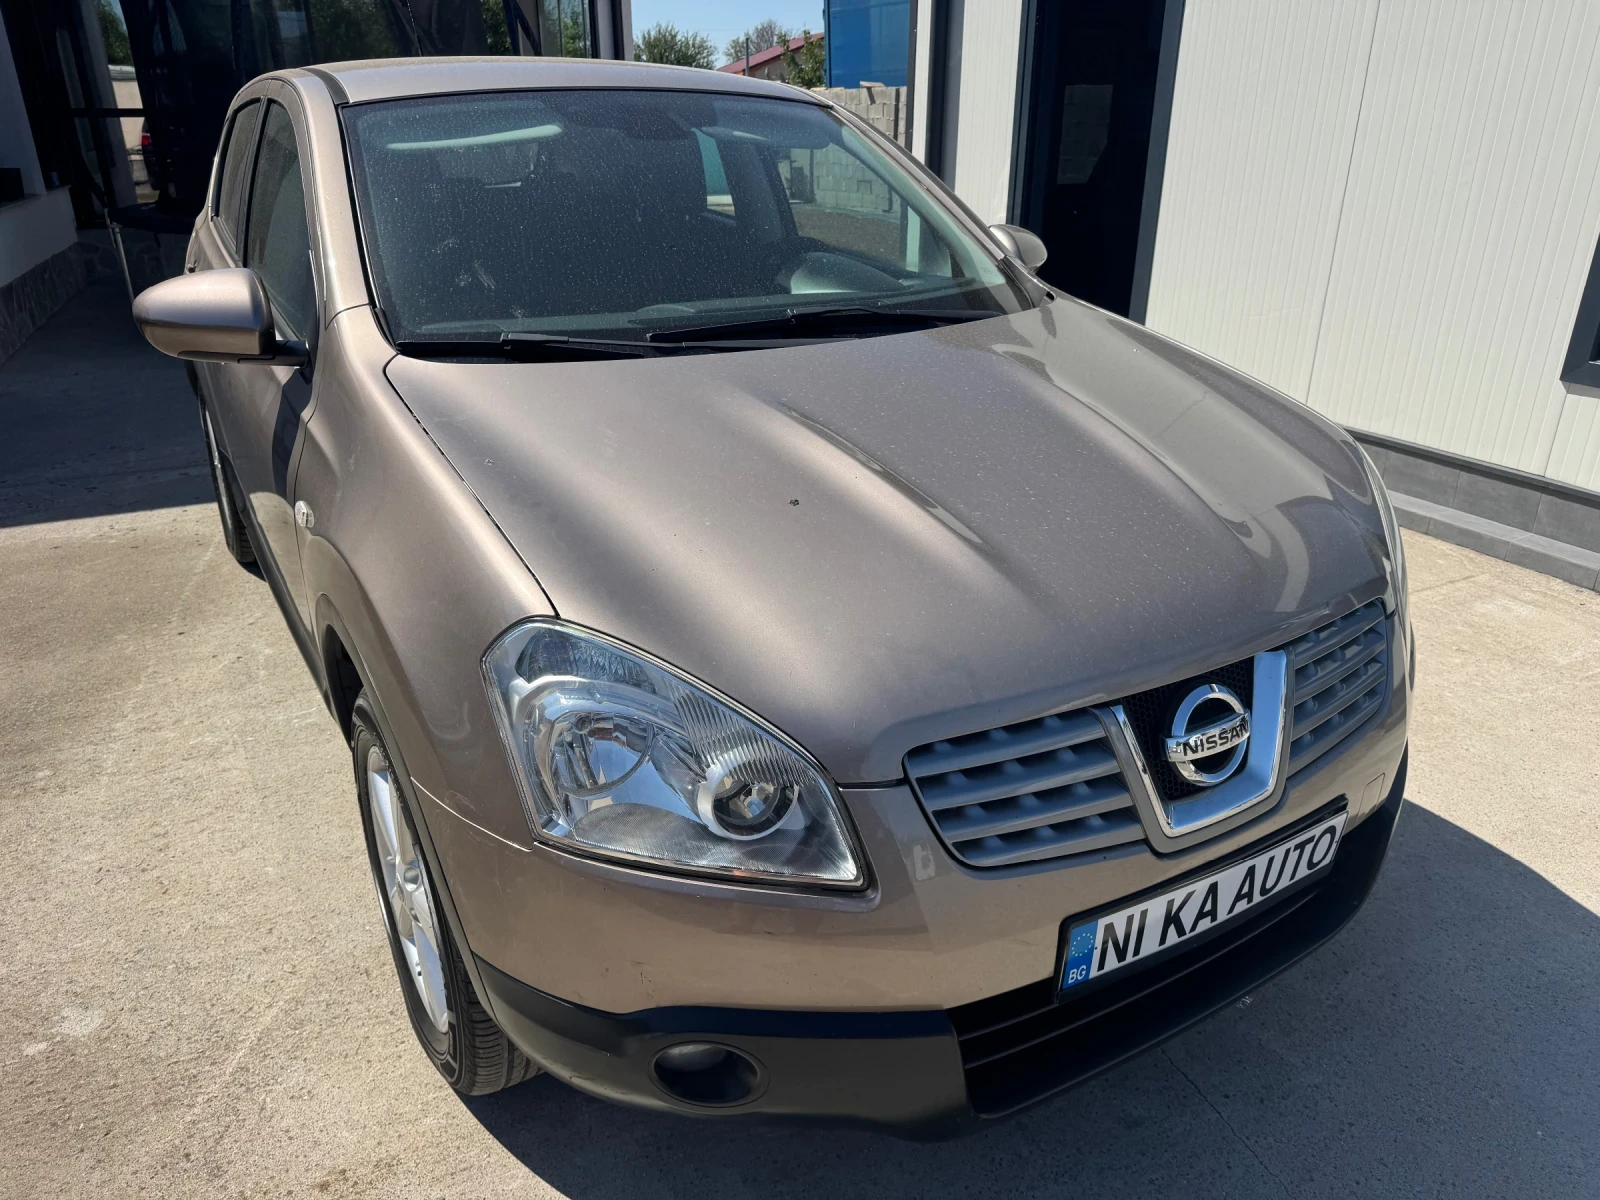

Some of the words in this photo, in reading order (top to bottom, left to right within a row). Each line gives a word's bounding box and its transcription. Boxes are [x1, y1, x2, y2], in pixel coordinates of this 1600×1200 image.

[1183, 718, 1249, 757] NISSAN
[1097, 908, 1148, 972] NI
[1158, 882, 1219, 947] KA
[1227, 825, 1337, 916] AUTO
[1068, 964, 1086, 984] BG
